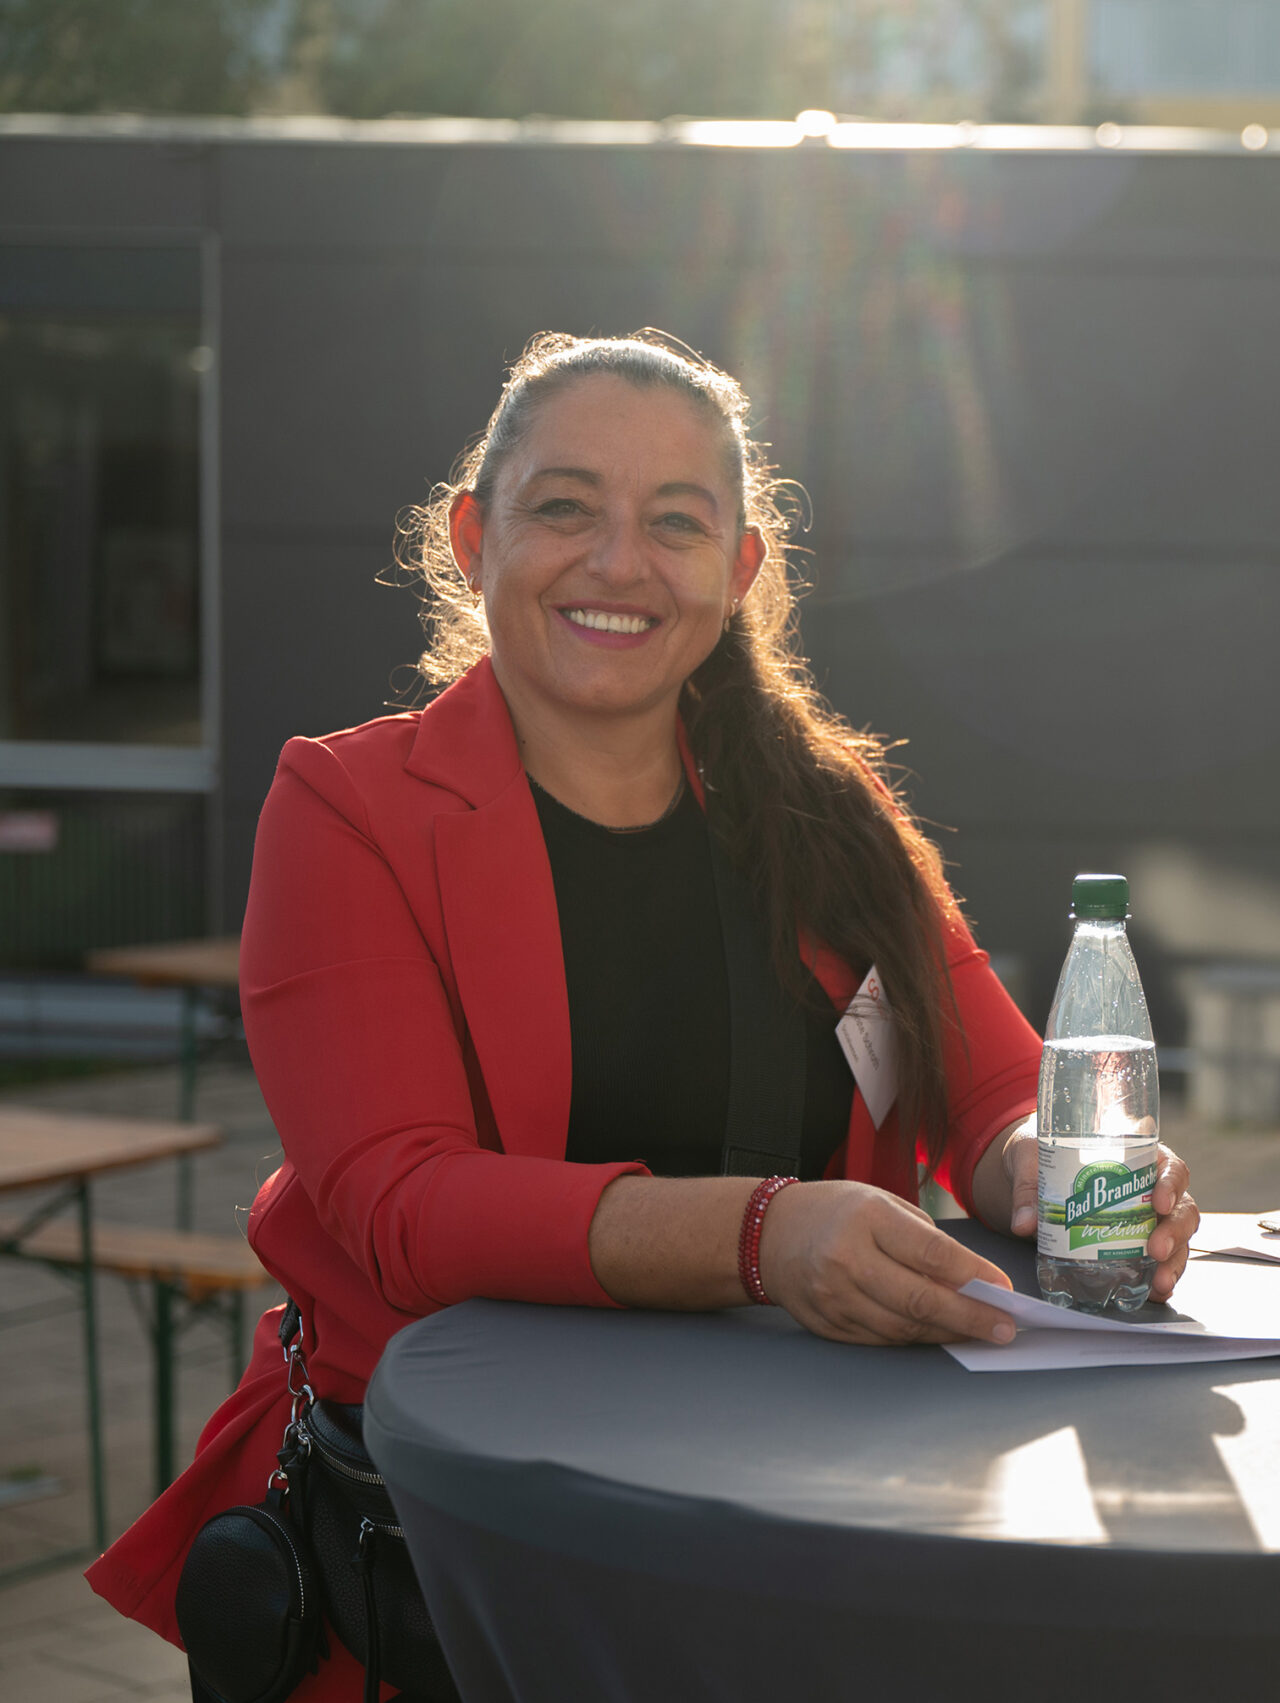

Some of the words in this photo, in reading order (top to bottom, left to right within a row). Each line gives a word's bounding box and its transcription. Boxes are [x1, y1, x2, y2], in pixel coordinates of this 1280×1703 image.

[1067, 1192, 1090, 1222] Bad
[1094, 1167, 1157, 1208] Brambache
[1081, 1220, 1152, 1241] medium
